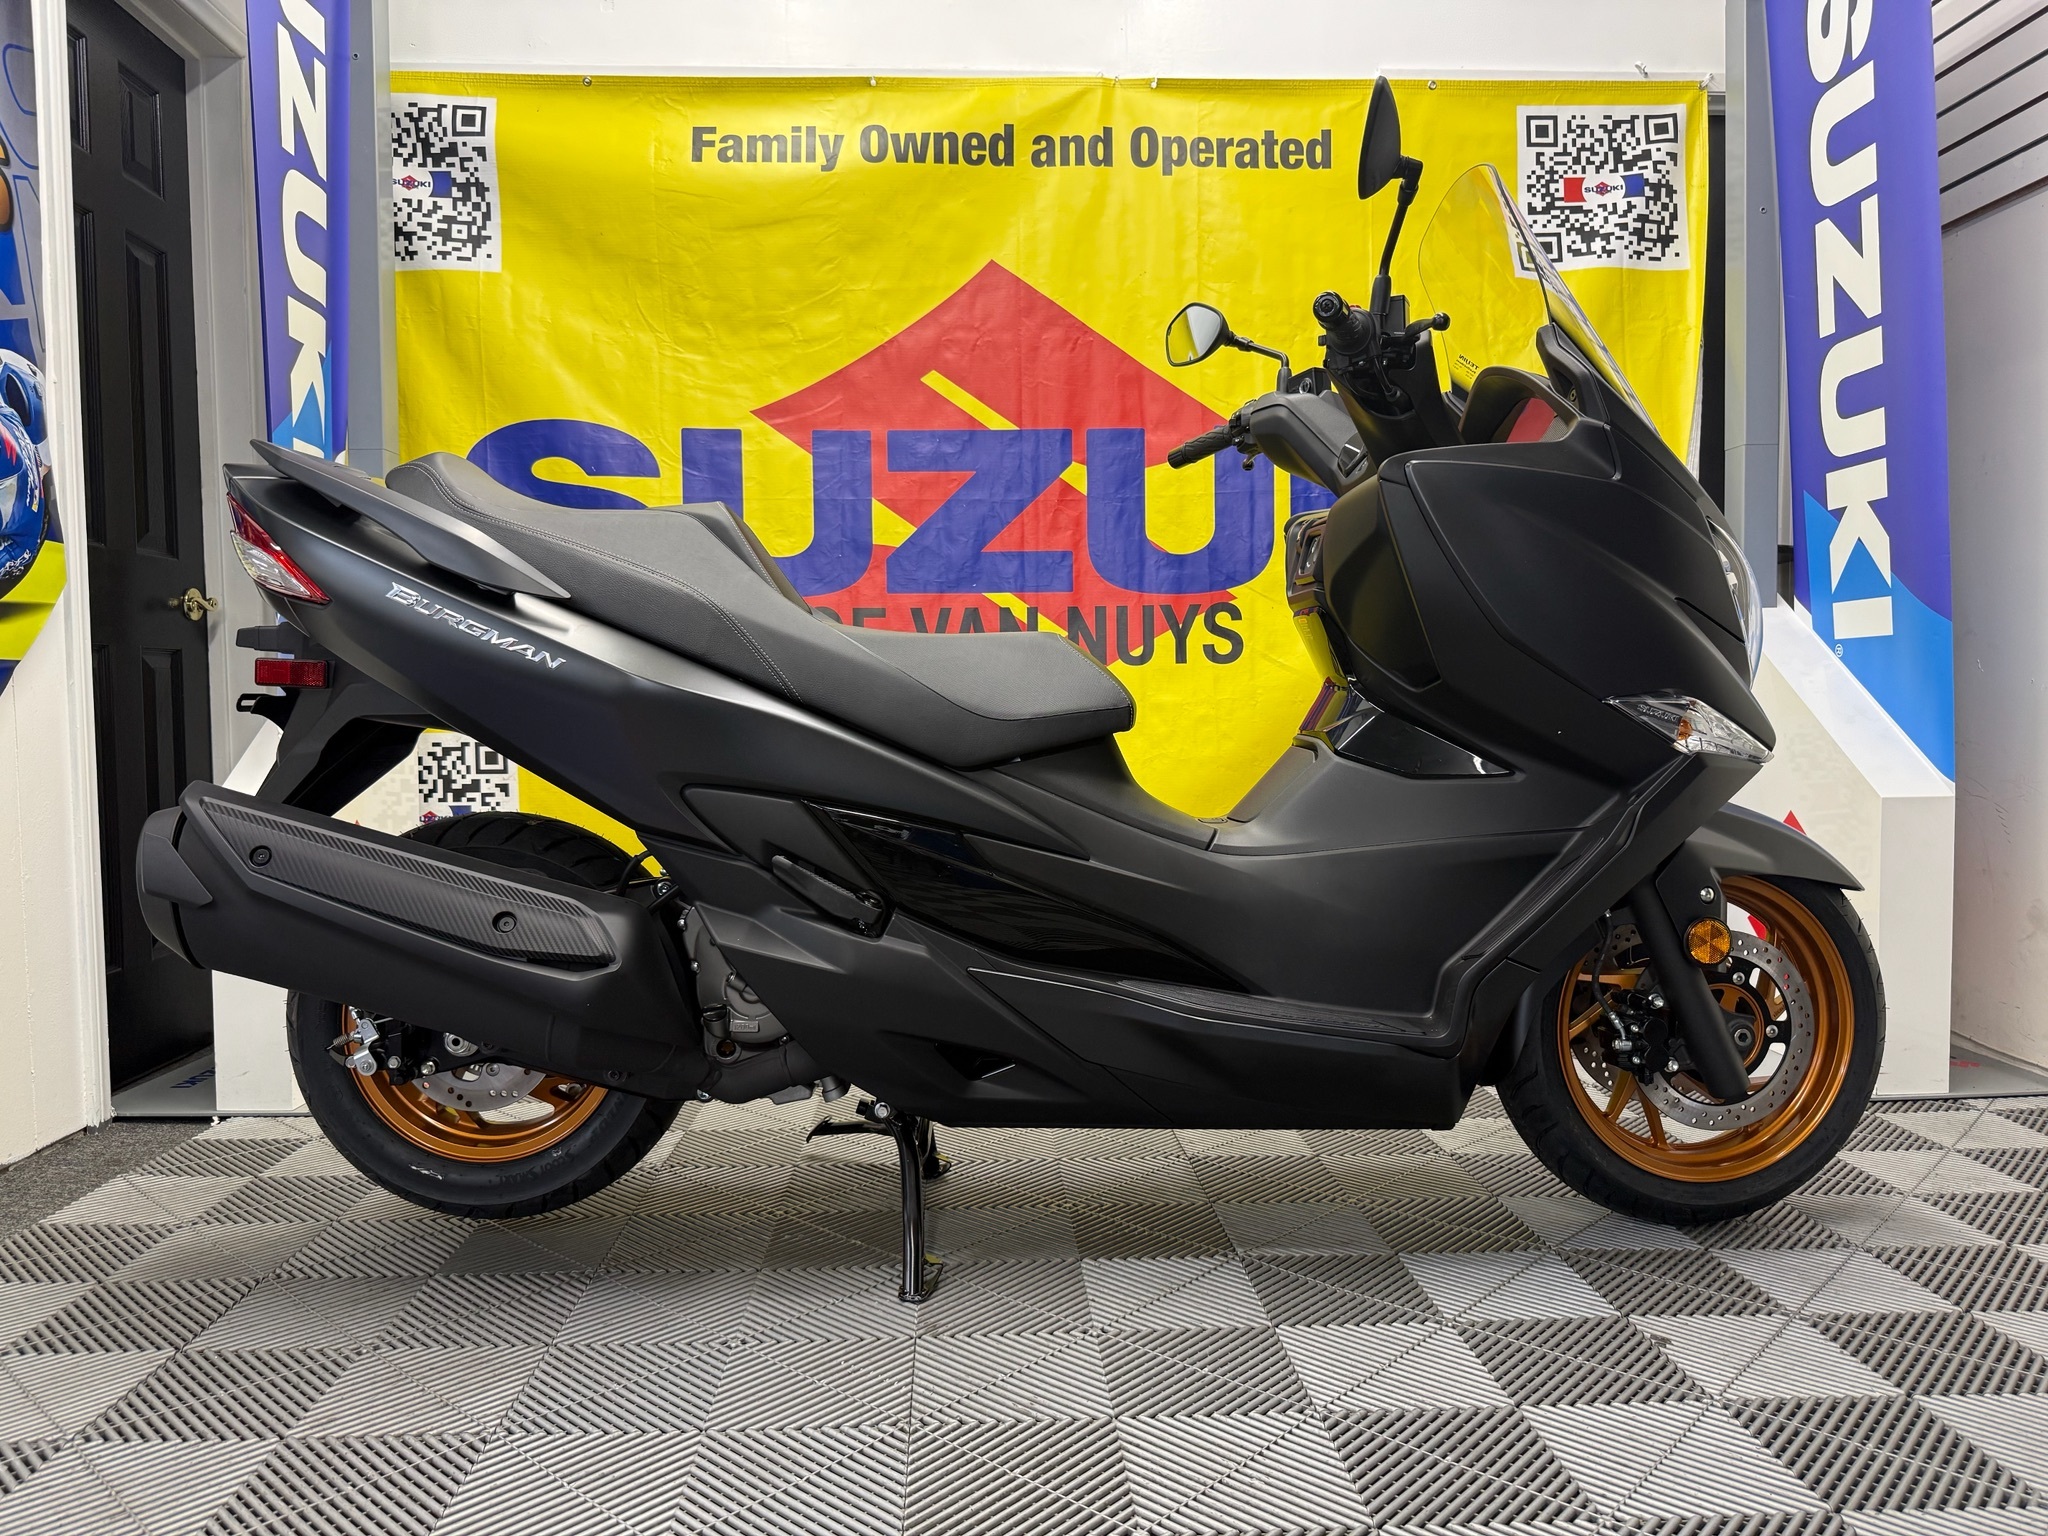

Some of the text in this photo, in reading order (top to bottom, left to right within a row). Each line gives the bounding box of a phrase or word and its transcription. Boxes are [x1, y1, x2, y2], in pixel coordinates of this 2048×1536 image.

[691, 123, 1332, 176] Family Owned and Operated
[1584, 184, 1623, 193] SUZUKI
[386, 581, 566, 669] BURGMAN
[1066, 601, 1244, 668] NUYS
